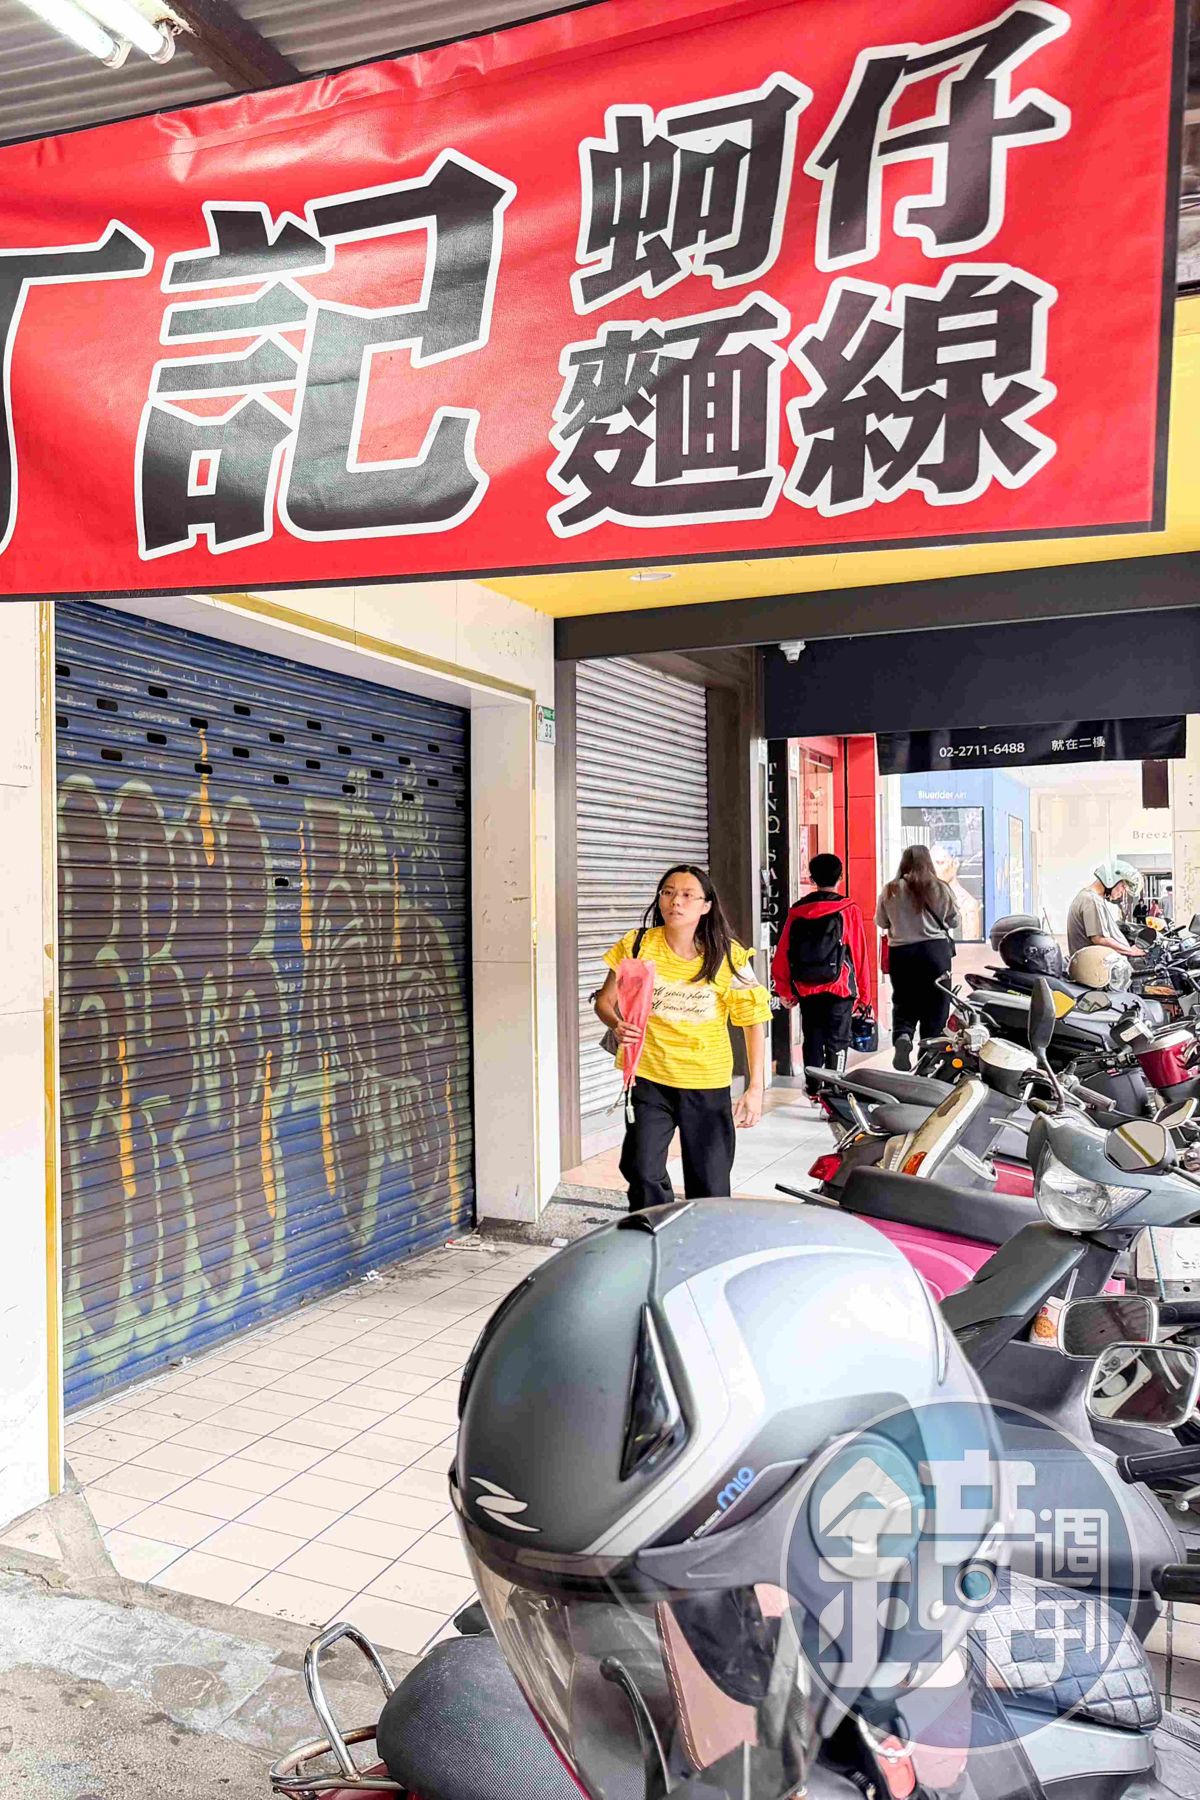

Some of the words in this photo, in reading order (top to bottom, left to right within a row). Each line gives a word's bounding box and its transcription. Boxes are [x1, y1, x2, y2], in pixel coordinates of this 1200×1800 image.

[569, 1, 1071, 315] 蚵仔
[542, 262, 1058, 538] 麵線
[939, 742, 1025, 758] 02-2711-6488
[1051, 736, 1106, 751] 就在二樓
